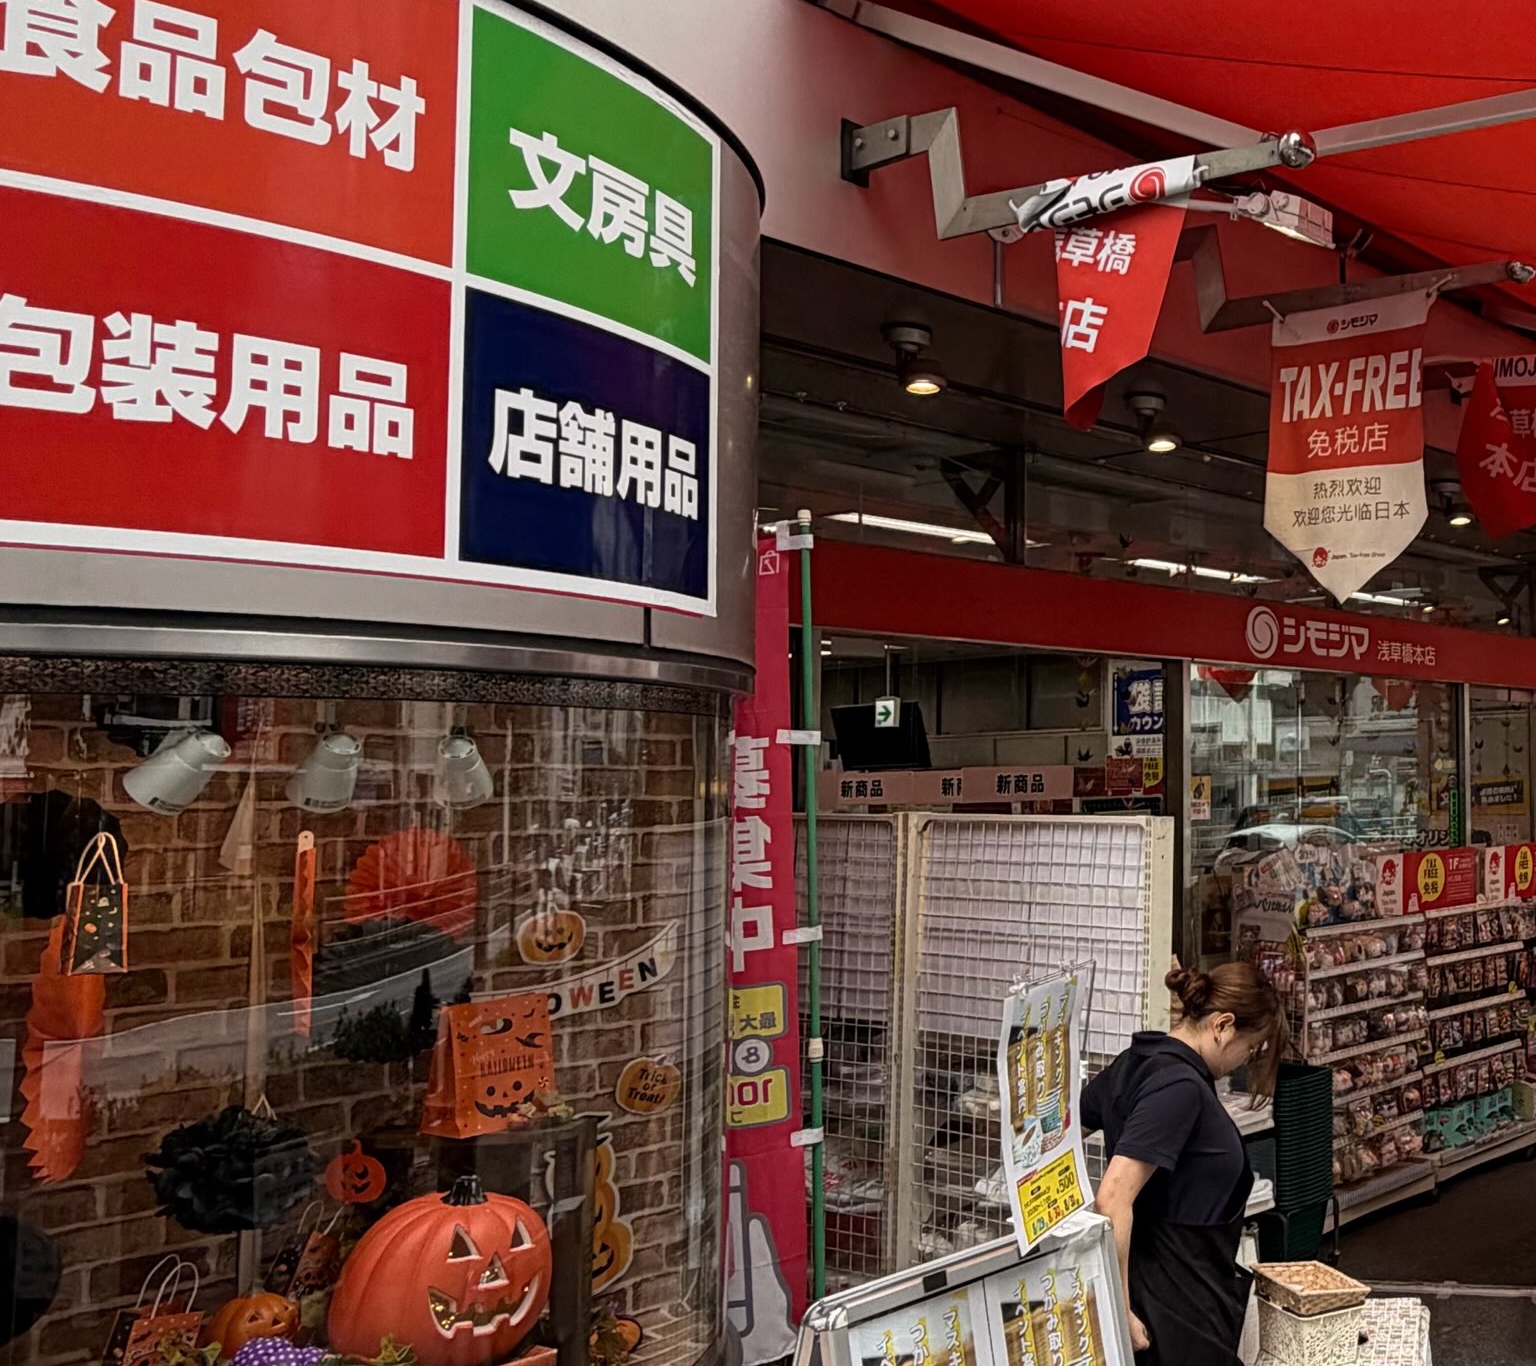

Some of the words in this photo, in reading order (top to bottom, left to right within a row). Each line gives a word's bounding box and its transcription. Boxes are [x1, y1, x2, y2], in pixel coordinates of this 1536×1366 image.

[508, 127, 696, 287] 文房具
[1059, 297, 1109, 354] 店
[0, 293, 414, 459] 包装用品
[1279, 347, 1423, 424] TAX-FREE
[488, 388, 698, 521] 店舗用品
[1307, 421, 1390, 458] 免税店
[1283, 616, 1370, 661] シモジマ
[1377, 639, 1437, 667] 浅草橋本店
[840, 779, 883, 798] 新商品
[996, 773, 1044, 795] 新商品
[638, 1068, 669, 1085] Trick
